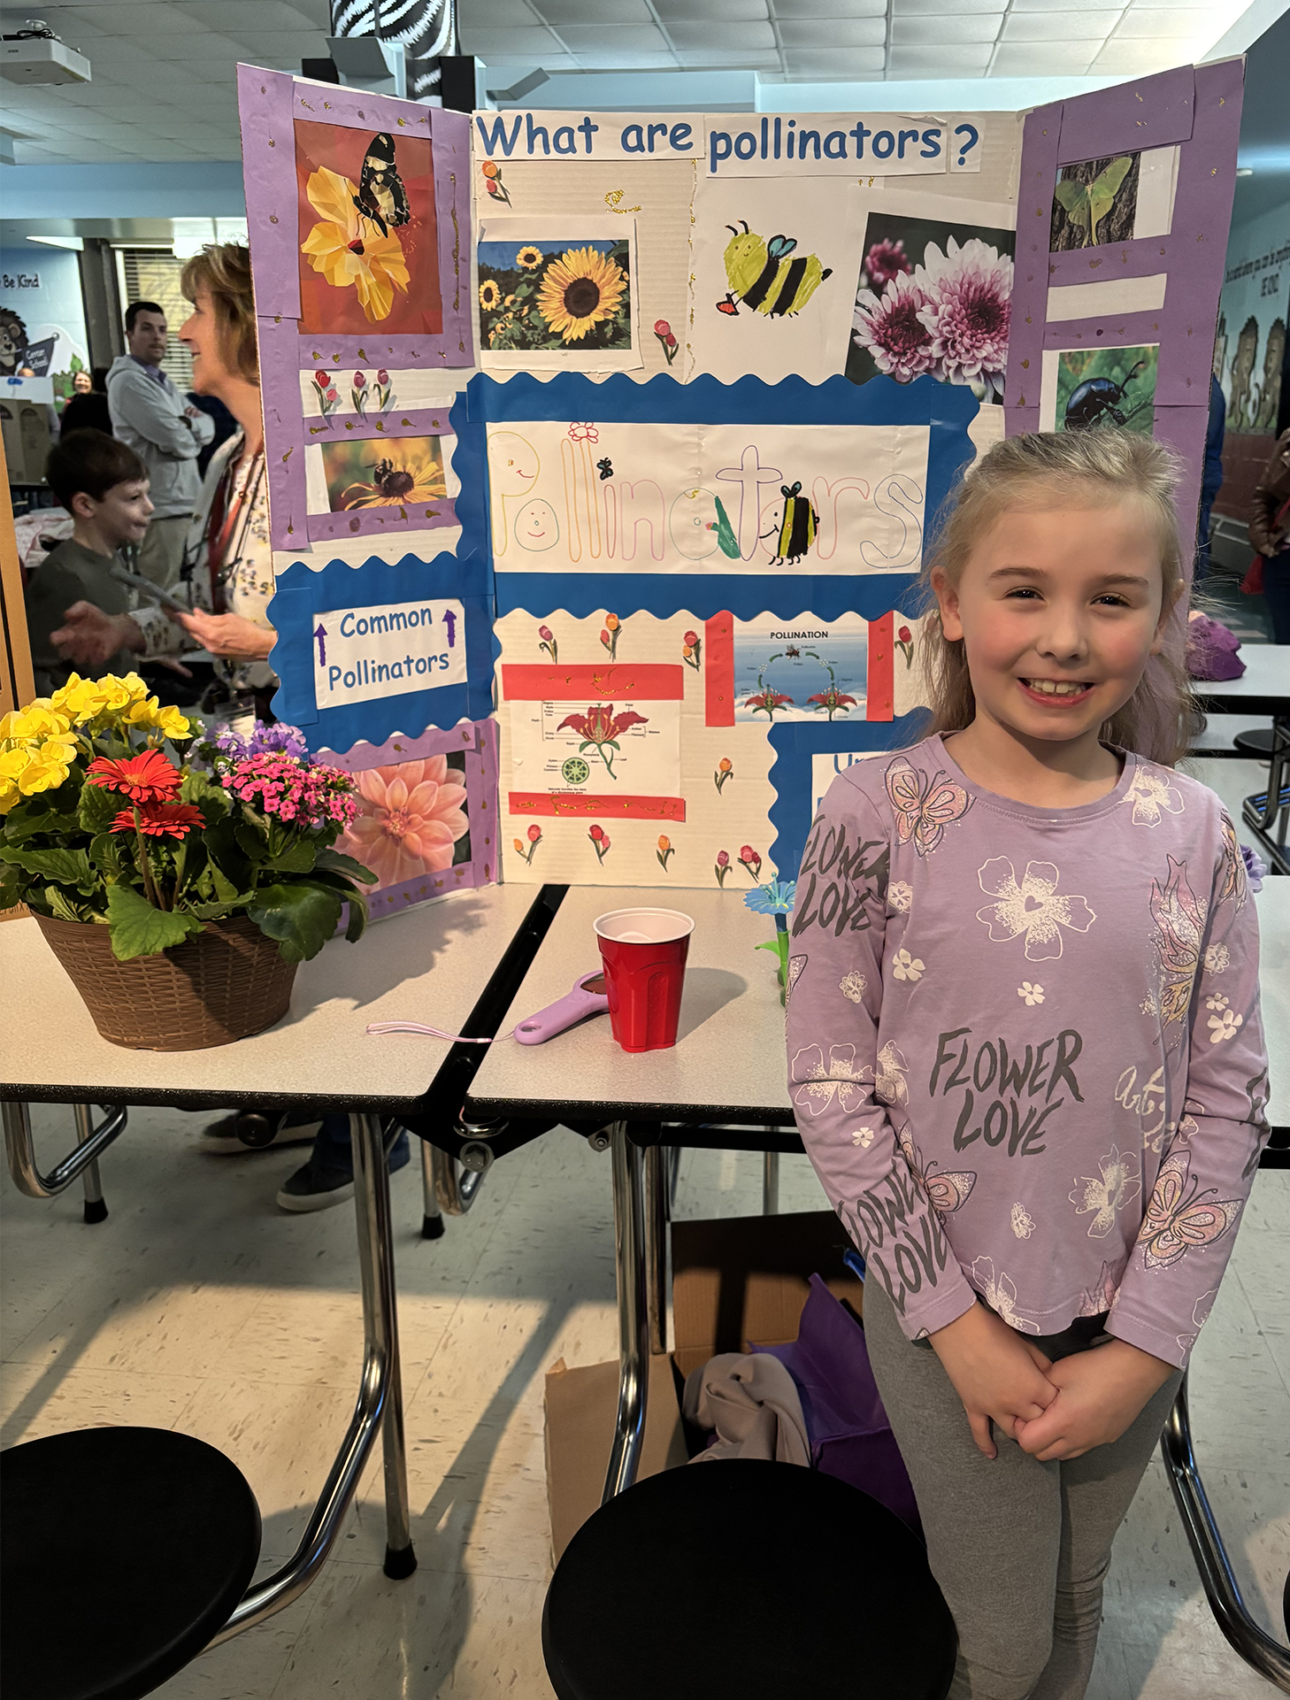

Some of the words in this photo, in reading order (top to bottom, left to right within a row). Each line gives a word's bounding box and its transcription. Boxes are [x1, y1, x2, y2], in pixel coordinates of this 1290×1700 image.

[475, 113, 599, 156] What
[621, 122, 694, 153] are
[709, 117, 942, 173] pollinators
[954, 123, 980, 166] ?
[3, 274, 15, 288] Be
[17, 273, 39, 289] Kind
[340, 608, 432, 637] Common
[770, 631, 828, 639] POLLINATION
[329, 653, 449, 691] Pollinators
[792, 872, 871, 938] LOVE
[929, 1027, 1084, 1103] FLOWER
[952, 1087, 1064, 1157] LOVE
